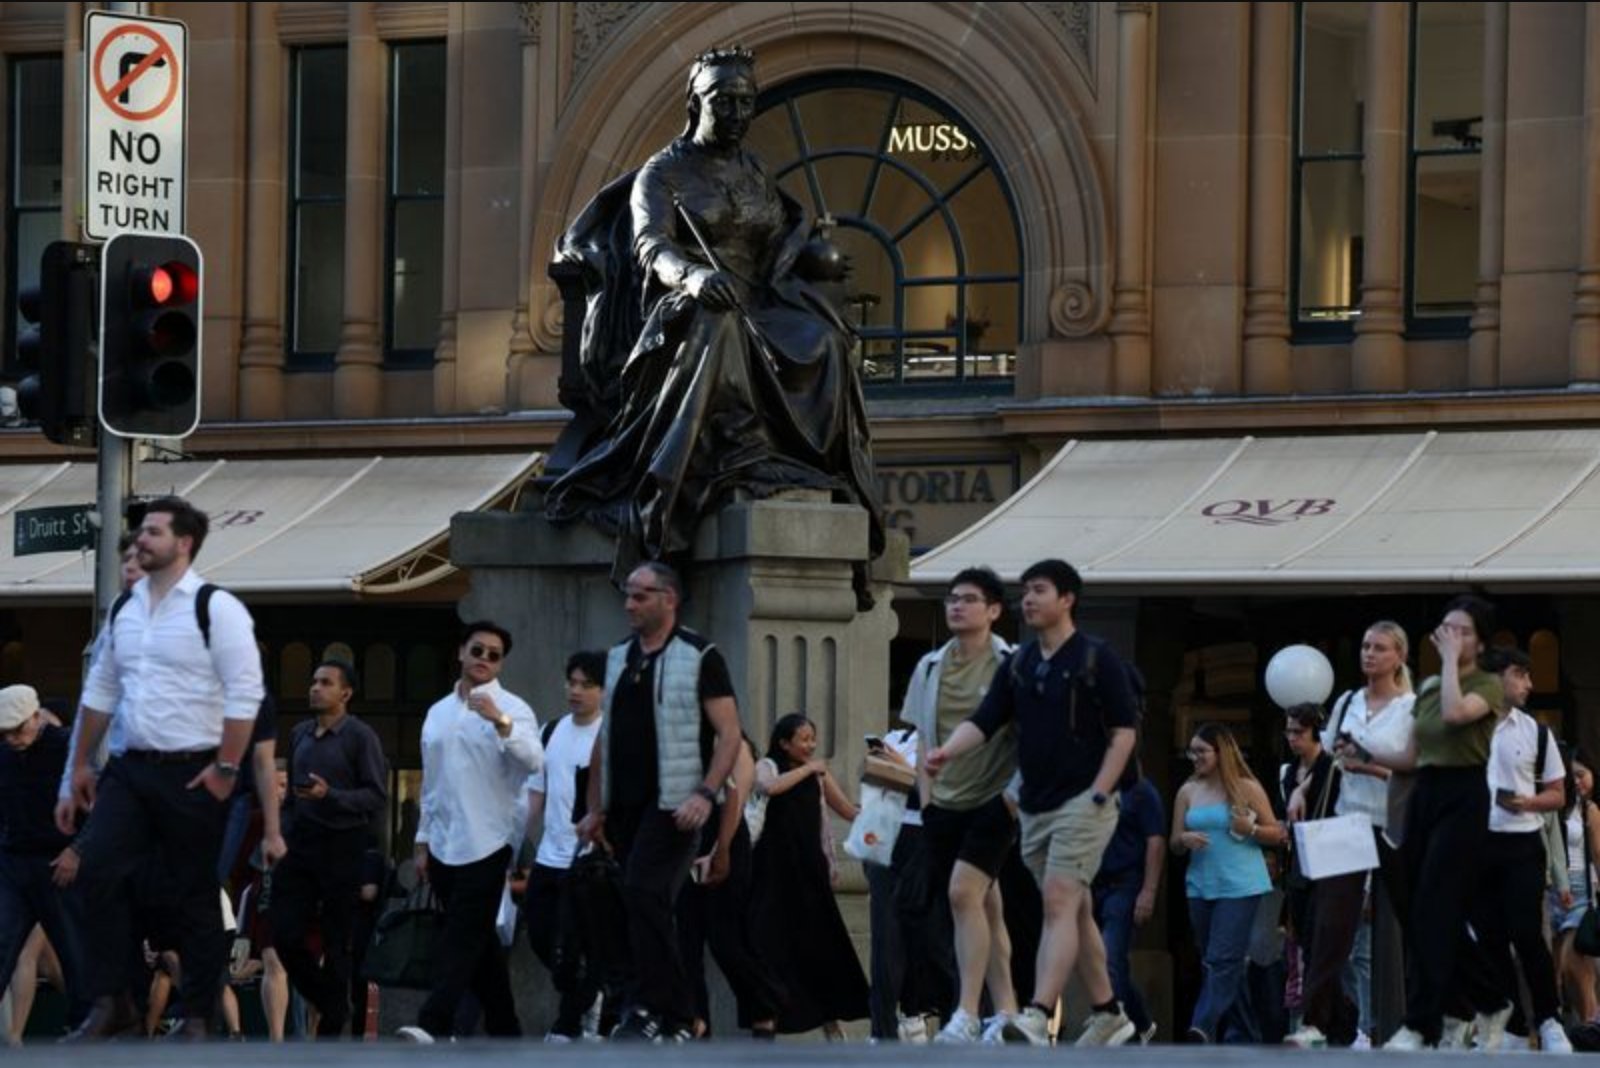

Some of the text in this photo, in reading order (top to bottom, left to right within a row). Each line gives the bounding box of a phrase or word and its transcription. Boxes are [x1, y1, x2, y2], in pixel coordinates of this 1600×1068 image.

[109, 129, 161, 165] NO
[887, 124, 977, 152] MUSS
[97, 171, 174, 199] RIGHT
[99, 204, 169, 231] TURN
[878, 467, 996, 504] TORIA
[29, 516, 66, 539] Druitt
[73, 512, 88, 534] St
[1201, 498, 1337, 527] QVB
